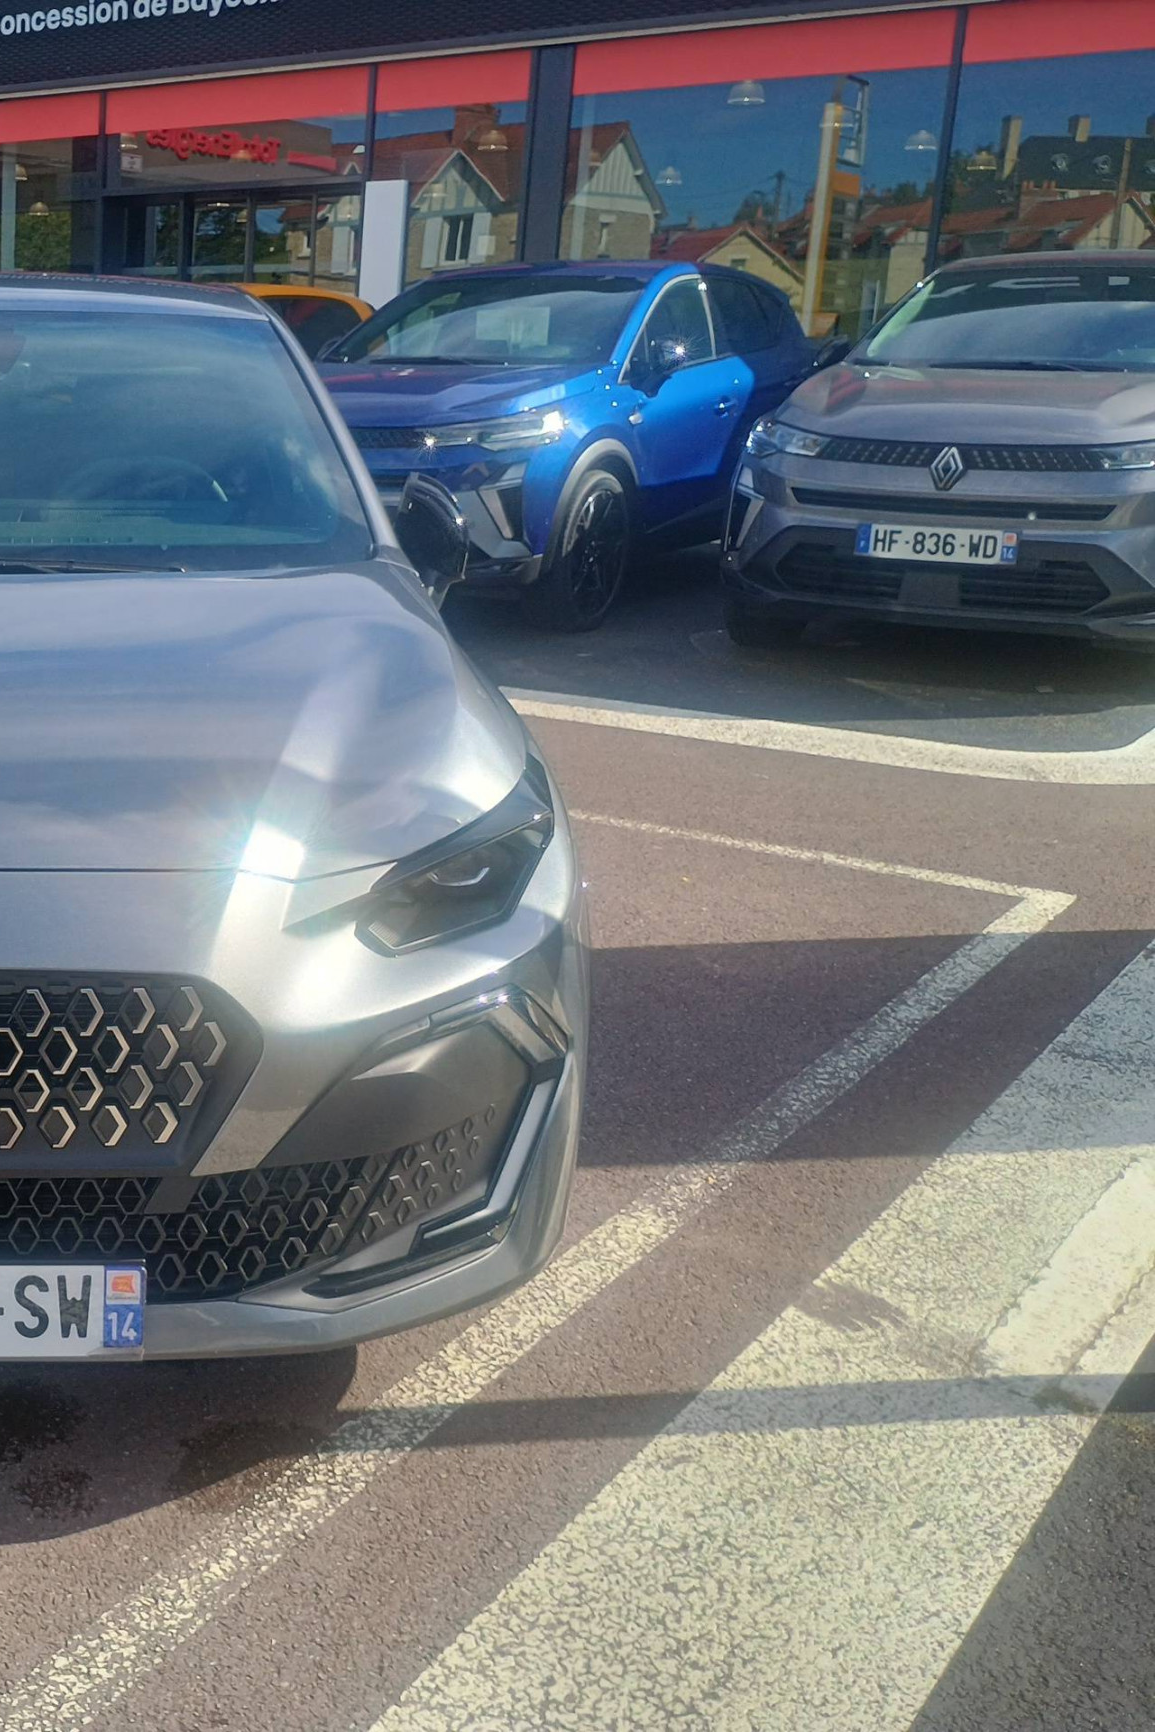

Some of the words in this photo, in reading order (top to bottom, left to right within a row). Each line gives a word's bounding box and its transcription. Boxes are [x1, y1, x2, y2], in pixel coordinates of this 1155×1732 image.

[132, 0, 168, 19] de
[872, 529, 998, 559] HF-836-WD
[1003, 548, 1014, 560] 14
[107, 1311, 138, 1341] 14
